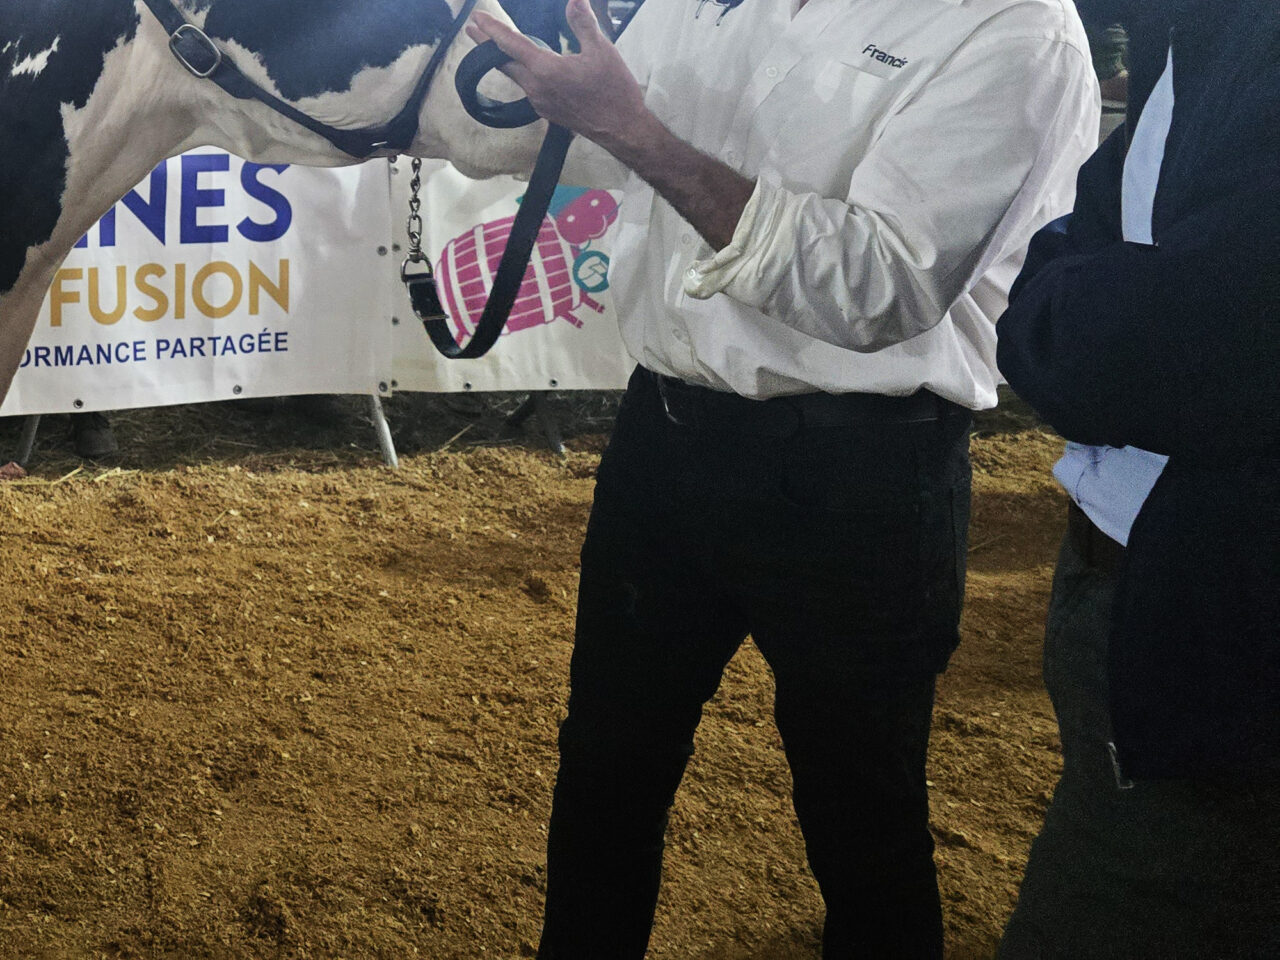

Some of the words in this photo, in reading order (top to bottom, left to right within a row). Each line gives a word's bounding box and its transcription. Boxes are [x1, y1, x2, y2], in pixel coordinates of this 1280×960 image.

[73, 153, 293, 249] NES
[50, 258, 290, 328] FUSION
[156, 328, 289, 359] PARTAGÉE
